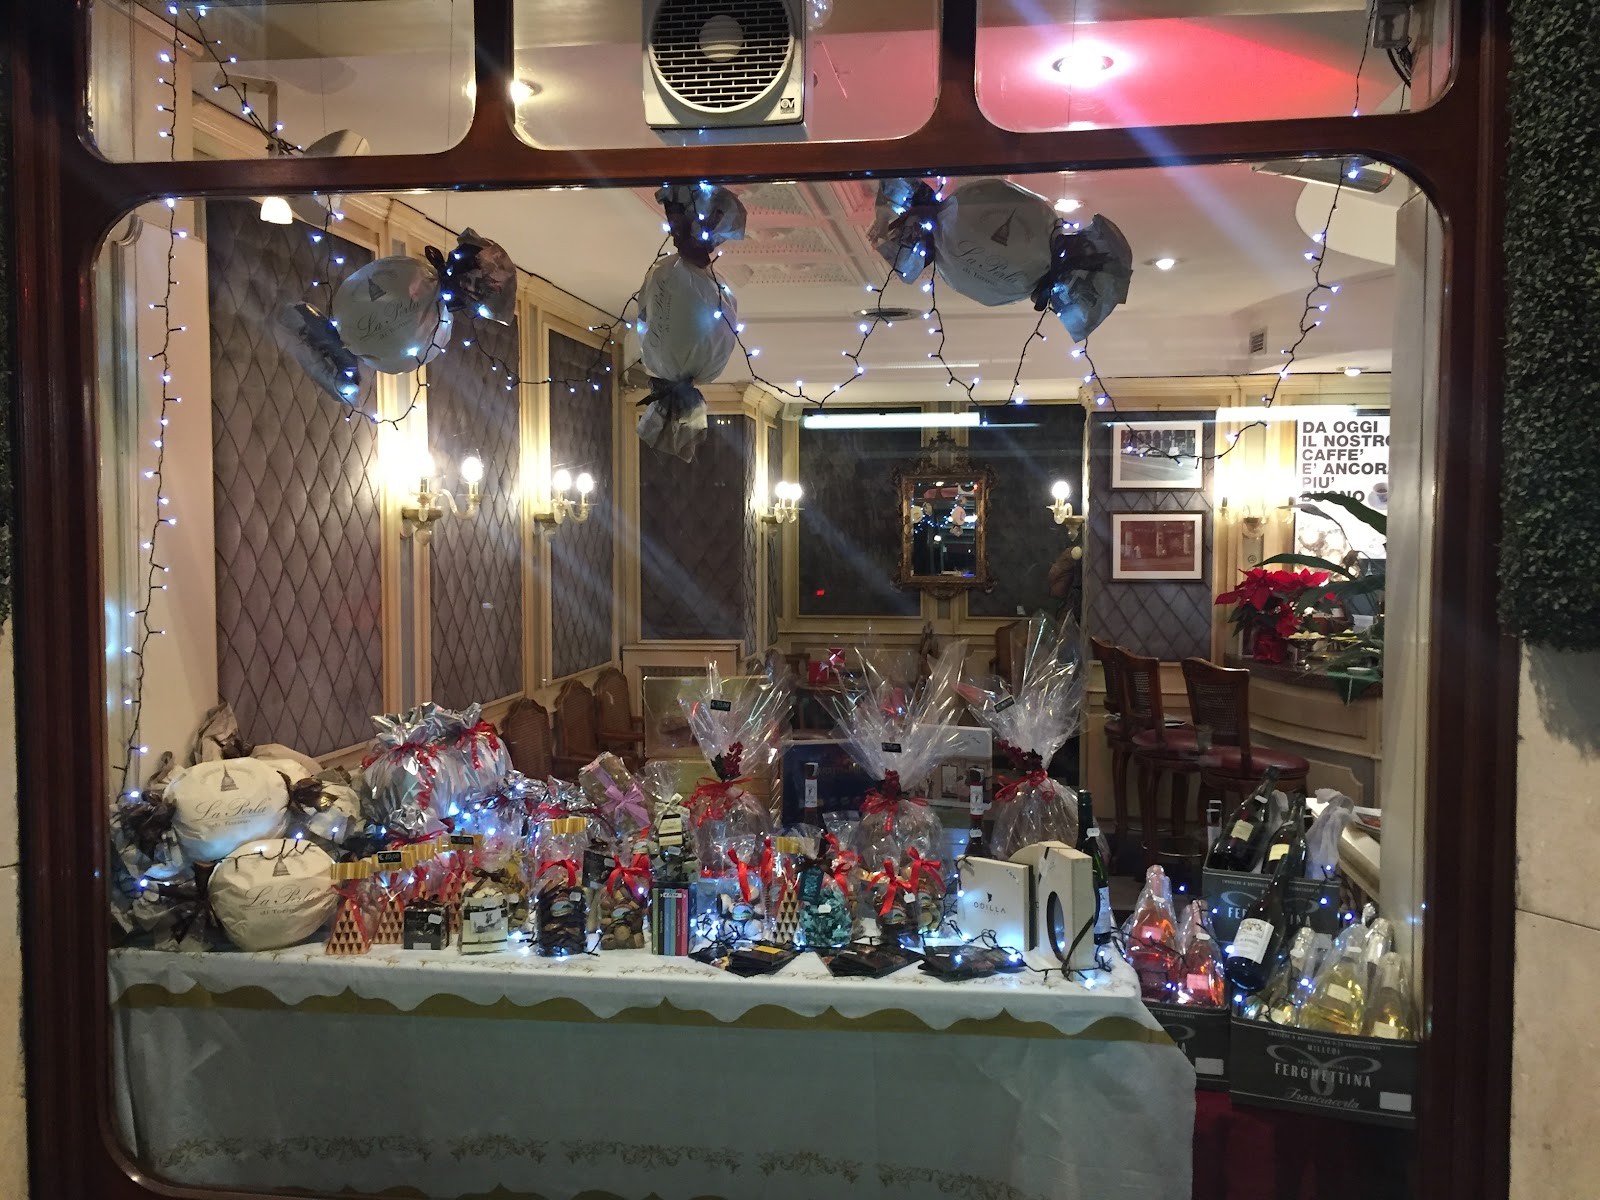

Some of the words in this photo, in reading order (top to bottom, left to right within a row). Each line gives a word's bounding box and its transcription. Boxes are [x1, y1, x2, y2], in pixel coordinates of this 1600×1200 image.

[952, 240, 985, 265] La
[984, 255, 1024, 284] Perla
[1302, 421, 1327, 434] DA
[1333, 420, 1378, 433] OGGI
[1302, 435, 1317, 447] IL
[1302, 448, 1364, 461] CAFFE'
[1302, 462, 1317, 475] E'
[1323, 462, 1389, 475] ANCOR
[1302, 476, 1335, 489] PIU'
[190, 799, 222, 822] La
[226, 797, 267, 818] Perla
[239, 885, 273, 907] La
[278, 884, 320, 905] Perla
[973, 901, 1007, 914] ODILLA
[1274, 1062, 1371, 1089] FERGHETTINA
